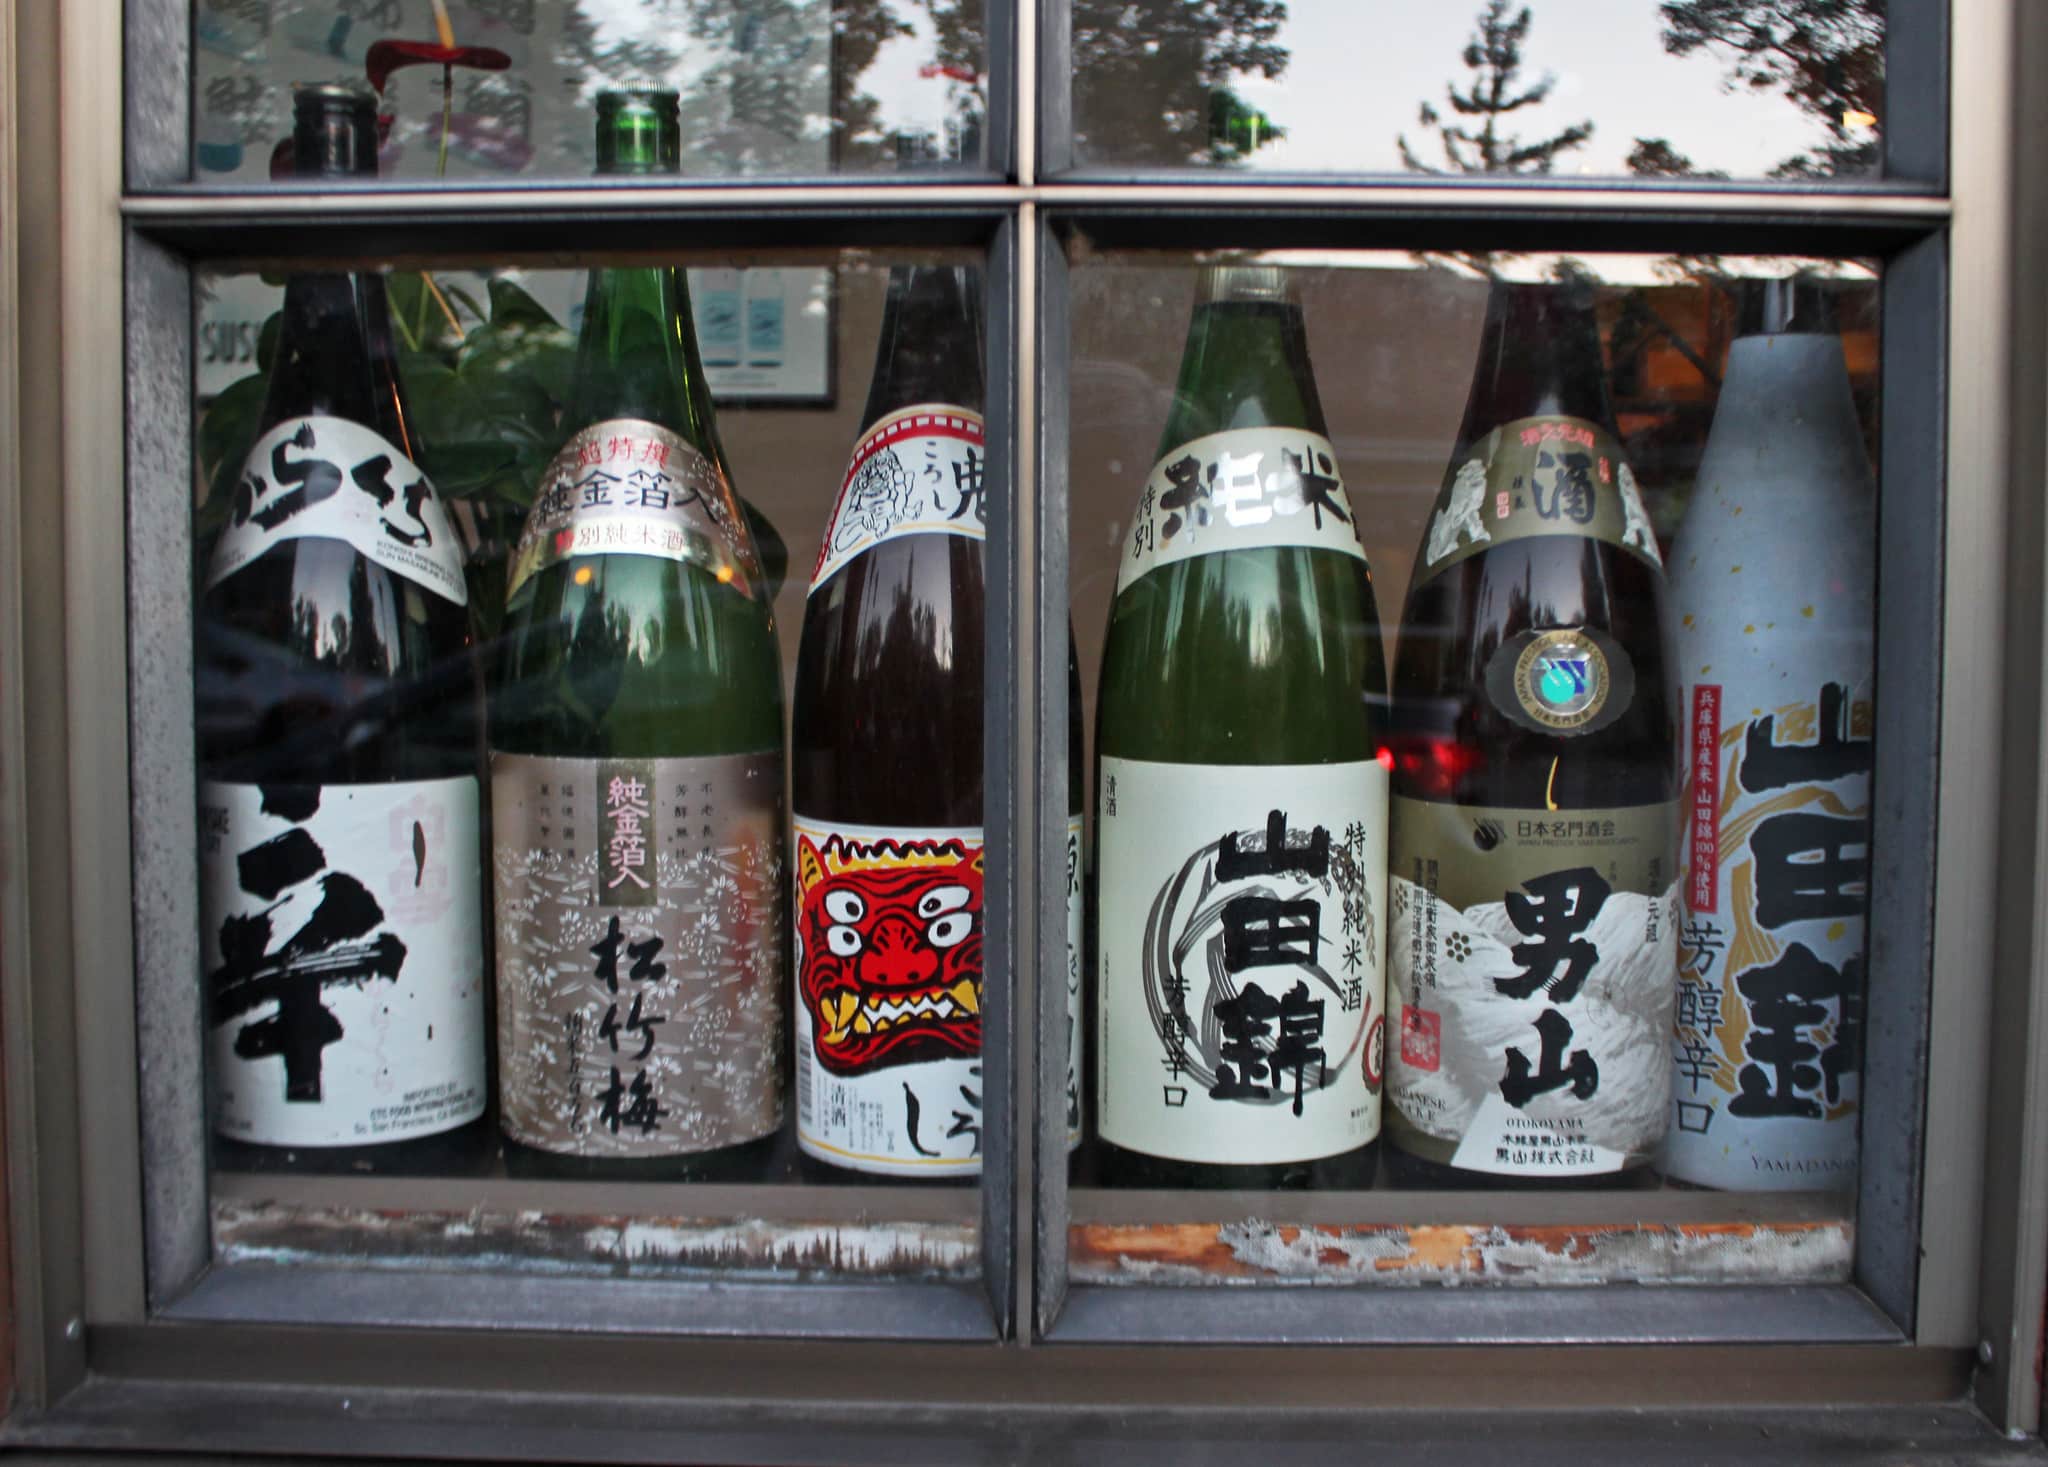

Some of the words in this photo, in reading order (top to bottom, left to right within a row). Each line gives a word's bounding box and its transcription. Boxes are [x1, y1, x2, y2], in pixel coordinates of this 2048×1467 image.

[924, 441, 946, 511] ころし
[1134, 485, 1156, 559] 特別
[607, 775, 650, 889] 純金箔入
[1105, 774, 1117, 817] 清酒
[1517, 820, 1617, 838] 日本名門酒会
[1209, 809, 1331, 1117] 山田錦
[1341, 820, 1367, 1013] 特別純米酒
[589, 915, 669, 1135] 松竹梅
[1493, 866, 1612, 1108] 男山
[1675, 921, 1726, 1135] 芳醇辛口
[1506, 1118, 1585, 1129] OTOKOYAMA
